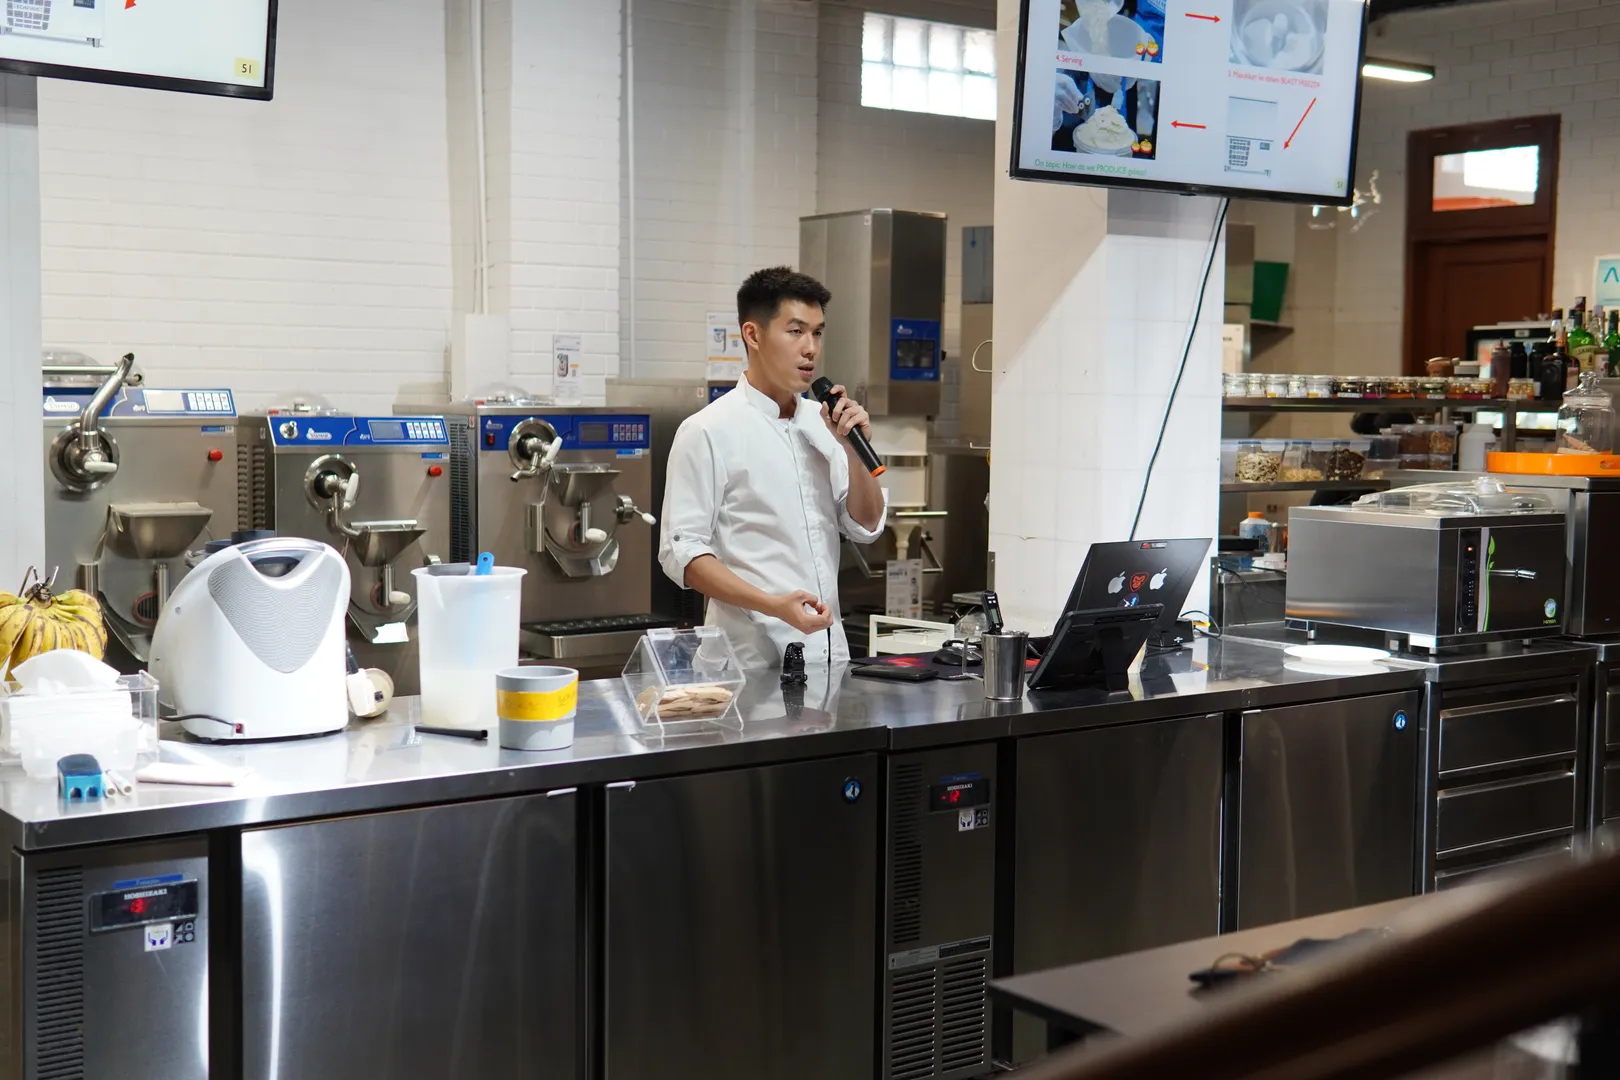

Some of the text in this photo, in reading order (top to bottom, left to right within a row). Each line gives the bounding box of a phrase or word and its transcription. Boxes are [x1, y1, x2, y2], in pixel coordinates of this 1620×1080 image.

[1062, 55, 1083, 67] Serving
[1034, 158, 1045, 167] On
[1062, 161, 1076, 169] How
[1096, 164, 1127, 174] PRODUCE
[124, 888, 168, 900] HOSHIZAKI
